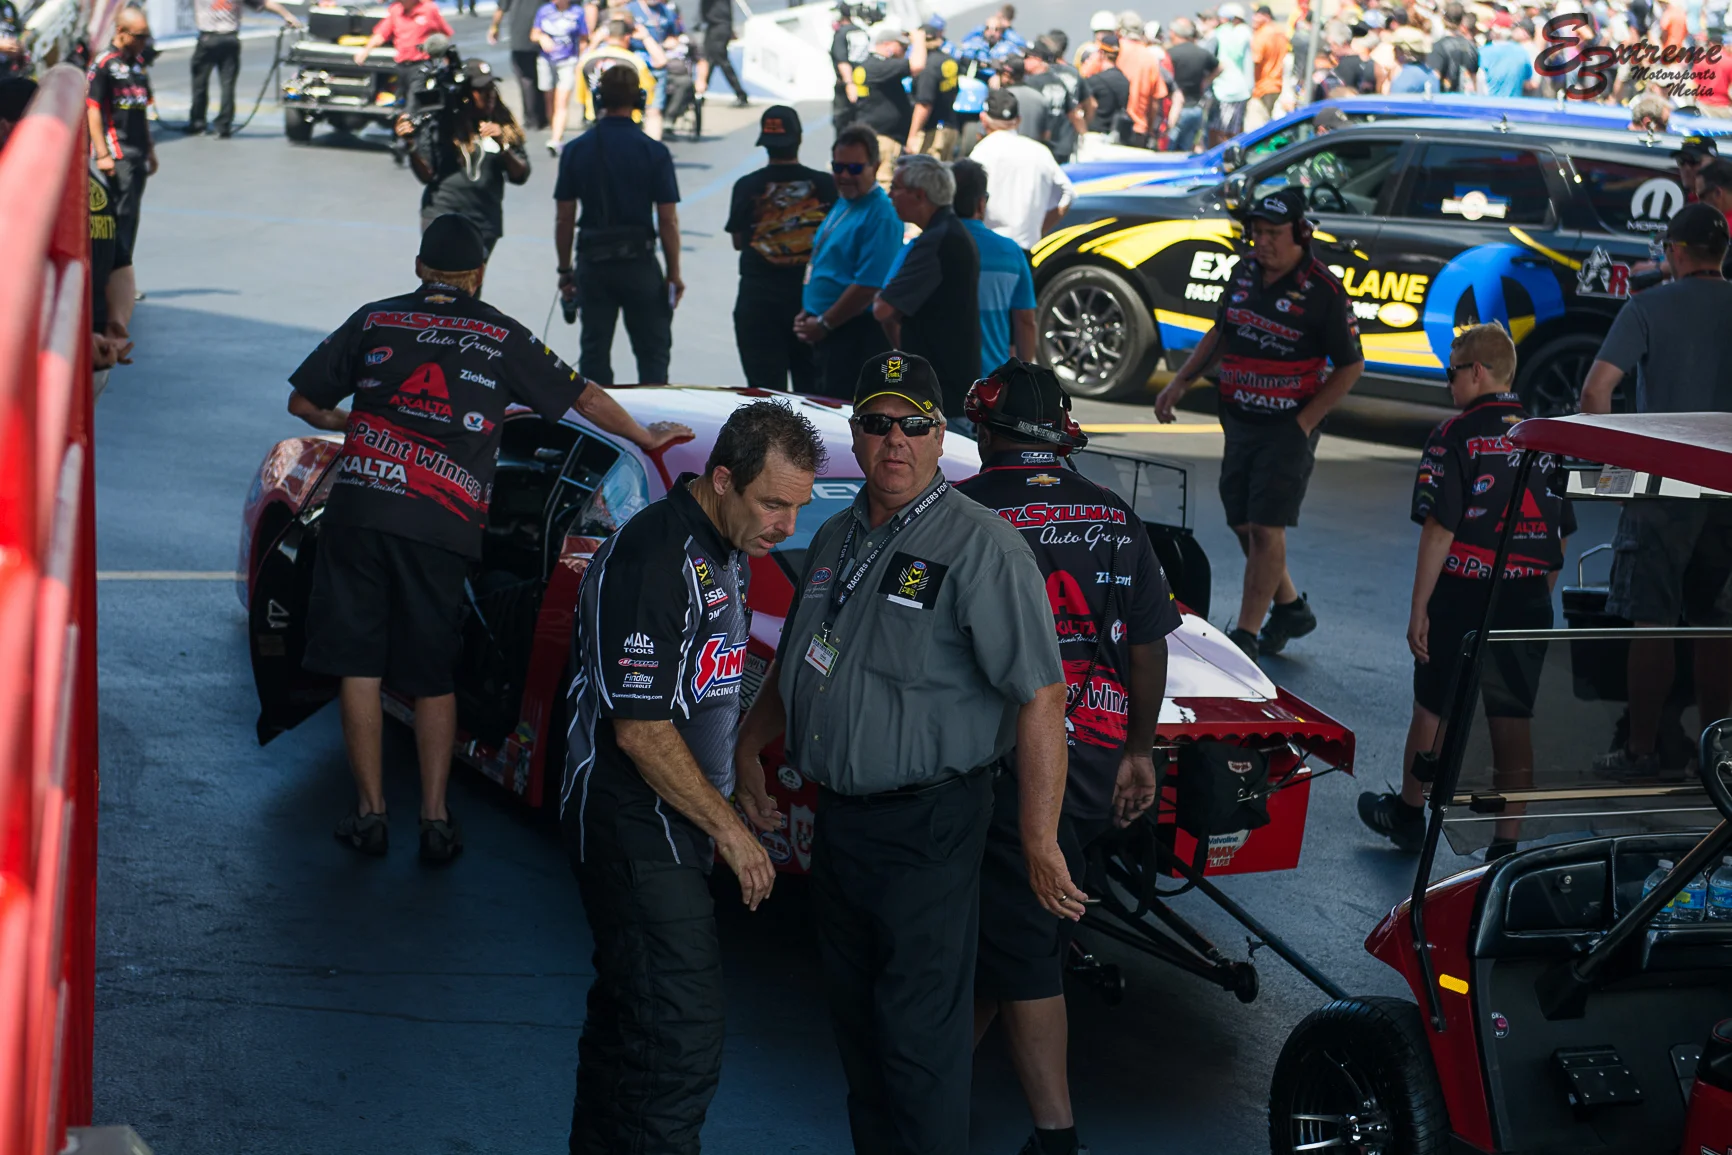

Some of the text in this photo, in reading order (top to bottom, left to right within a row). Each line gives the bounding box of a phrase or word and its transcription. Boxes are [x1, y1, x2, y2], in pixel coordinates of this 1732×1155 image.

[1184, 282, 1225, 303] FAST
[416, 329, 504, 361] Auto Group
[459, 368, 497, 390] Ziebart
[388, 394, 454, 417] AXALTA
[1233, 389, 1298, 410] AXALTA
[338, 454, 408, 485] XALTA
[351, 421, 412, 462] Paint
[414, 446, 482, 502] Winners
[914, 491, 939, 515] RACERS
[1040, 526, 1082, 545] Auto
[1495, 520, 1549, 534] AALTA
[846, 549, 880, 591] RACERS FOR
[623, 632, 655, 649] MAC
[623, 647, 655, 655] TOOLS
[624, 672, 654, 685] Findlay
[611, 692, 663, 701] SummitRacing.com
